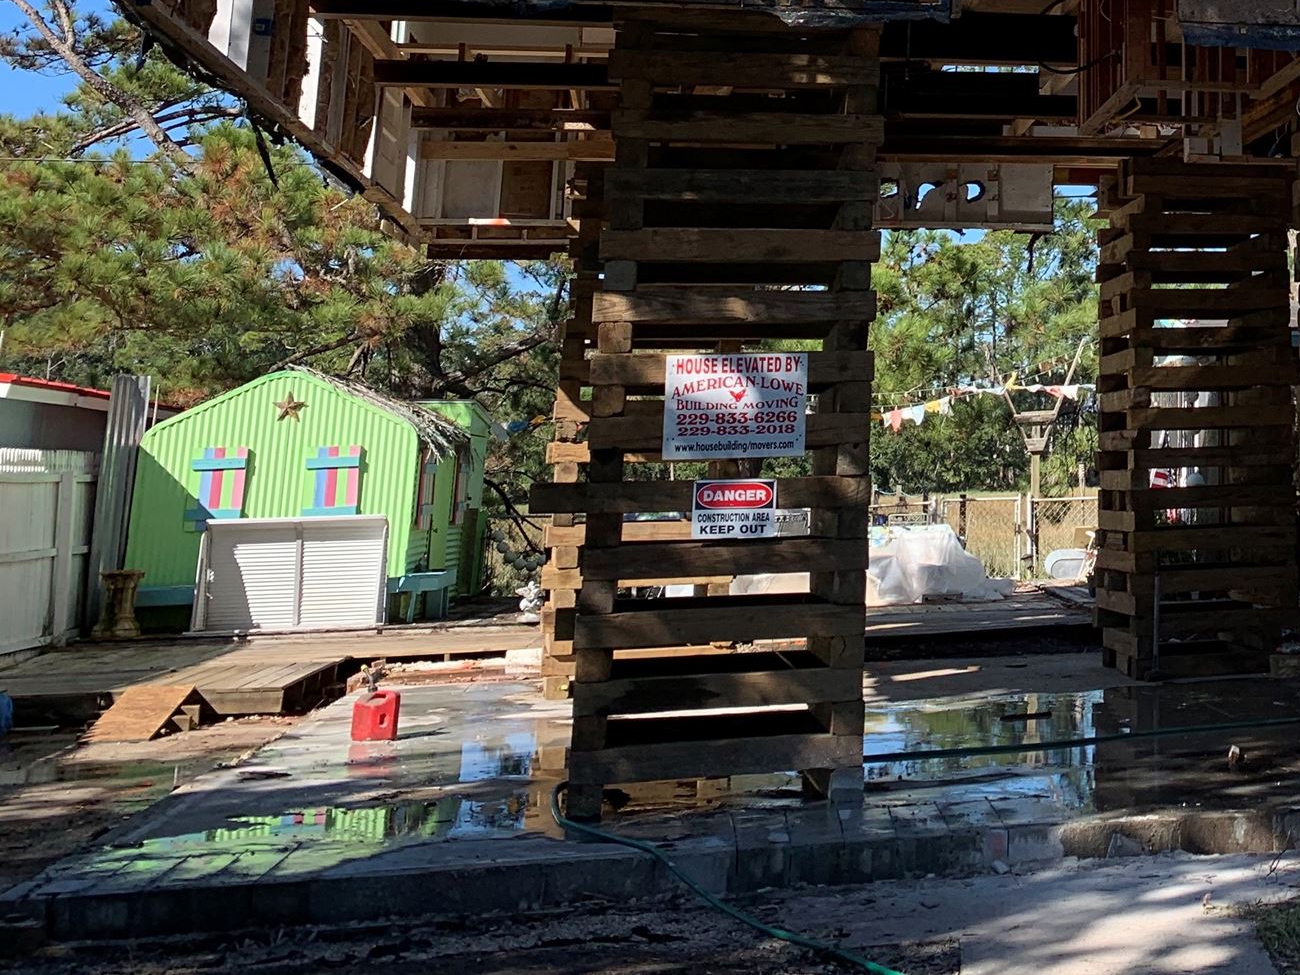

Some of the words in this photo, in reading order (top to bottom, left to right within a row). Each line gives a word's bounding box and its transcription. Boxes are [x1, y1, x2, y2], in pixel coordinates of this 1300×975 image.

[676, 357, 717, 374] HOUSE
[721, 356, 781, 373] ELEVATED
[785, 355, 801, 371] BY
[672, 376, 803, 399] AMERICAN-LOWE
[676, 398, 737, 410] BUILDING
[743, 397, 798, 409] MOVING
[676, 411, 796, 424] 229-833-6266
[677, 424, 795, 436] 229-833-2018
[703, 489, 766, 501] DANGER
[697, 513, 749, 522] CONSTRUCTION
[752, 512, 770, 521] AREA
[699, 525, 734, 534] KEEP
[739, 524, 766, 533] OUT
